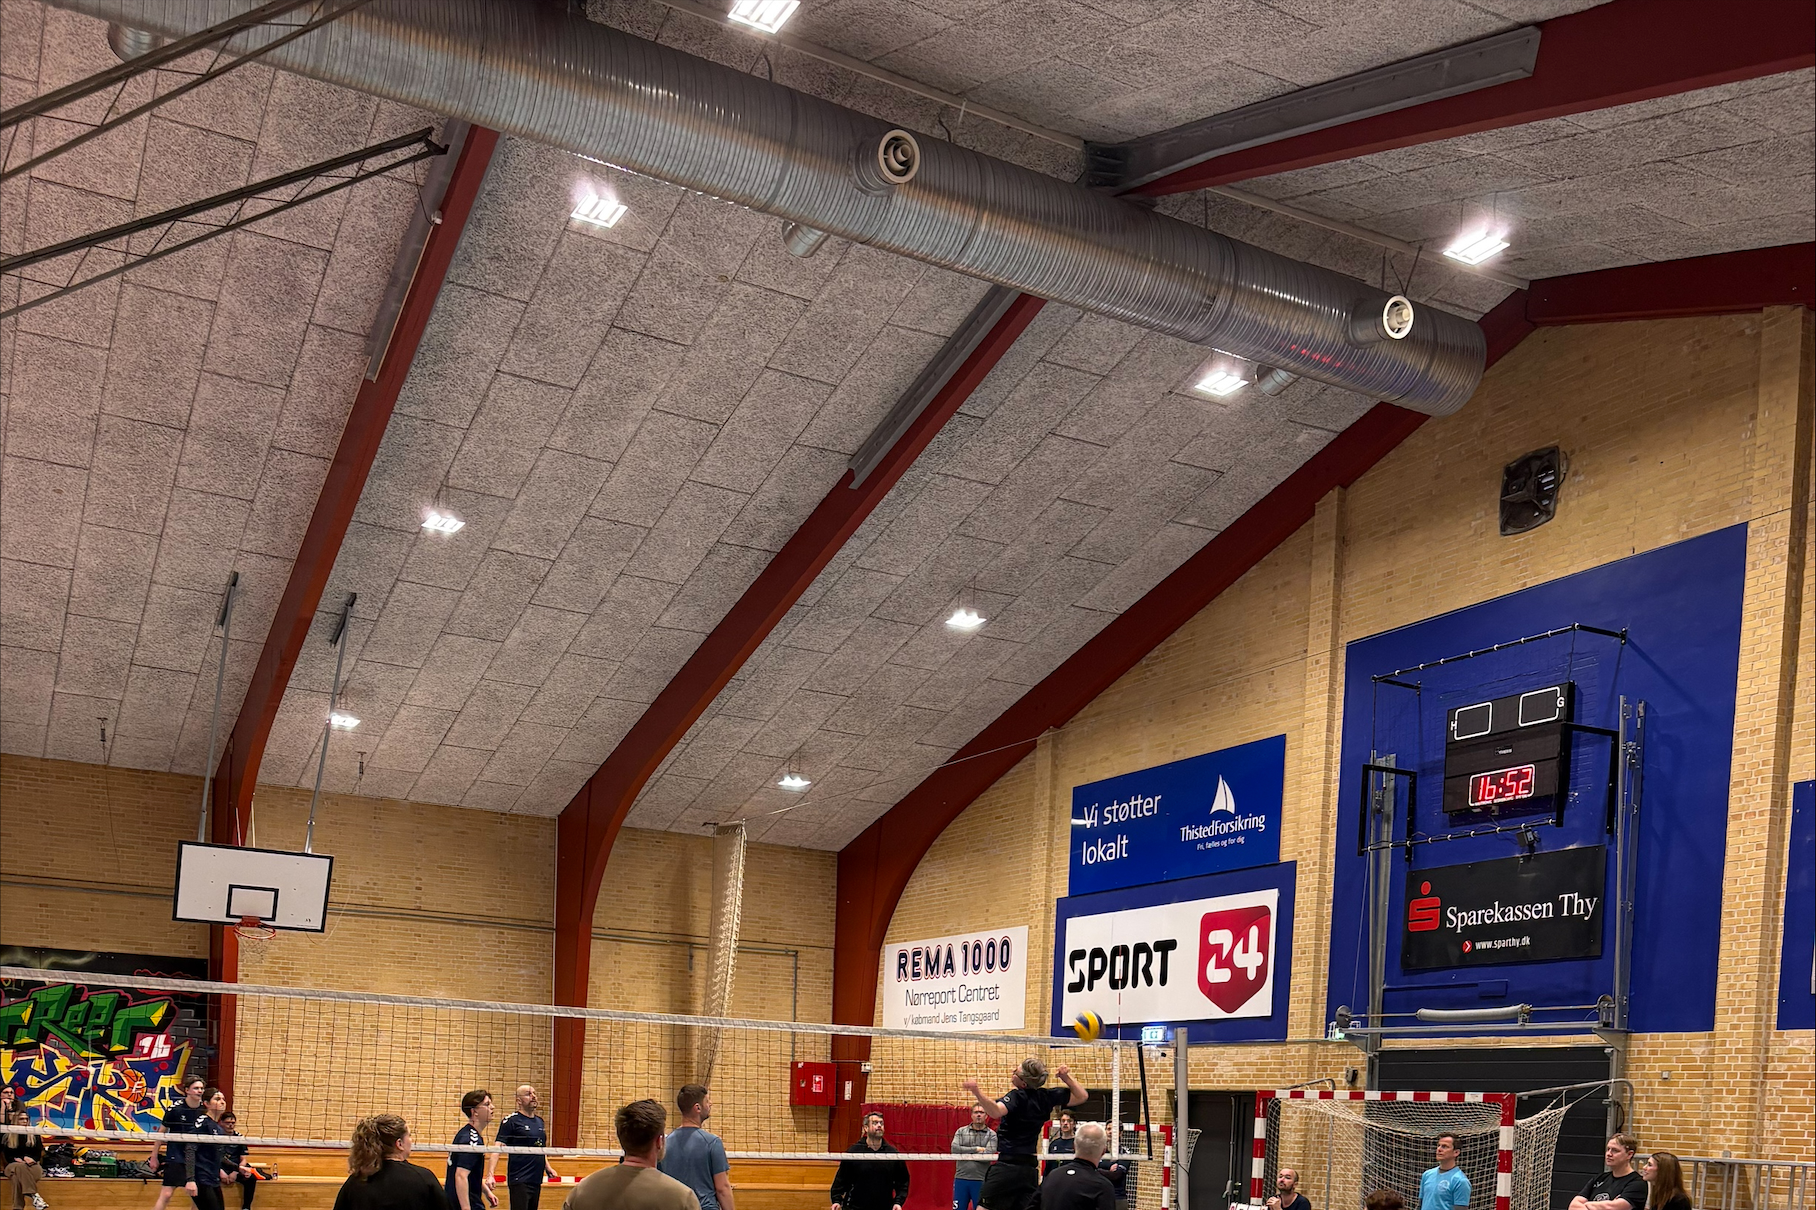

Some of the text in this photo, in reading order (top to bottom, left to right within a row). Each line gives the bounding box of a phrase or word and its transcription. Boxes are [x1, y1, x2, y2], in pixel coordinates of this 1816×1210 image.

[1556, 696, 1565, 707] G
[1450, 720, 1458, 731] H
[1478, 768, 1533, 800] 16:52
[1083, 794, 1162, 828] Vi støtter
[1082, 834, 1129, 865] lokalt
[1446, 892, 1598, 933] Sparekassen Thy
[1475, 935, 1531, 950] www.sparthy.dk
[897, 935, 1012, 982] REMA 1000
[1068, 925, 1264, 993] SPORT 24
[905, 983, 1000, 1010] Nørreport Centret
[911, 1012, 940, 1026] købmand
[941, 1011, 957, 1024] Jens
[958, 1008, 1000, 1026] Tangsgaard
